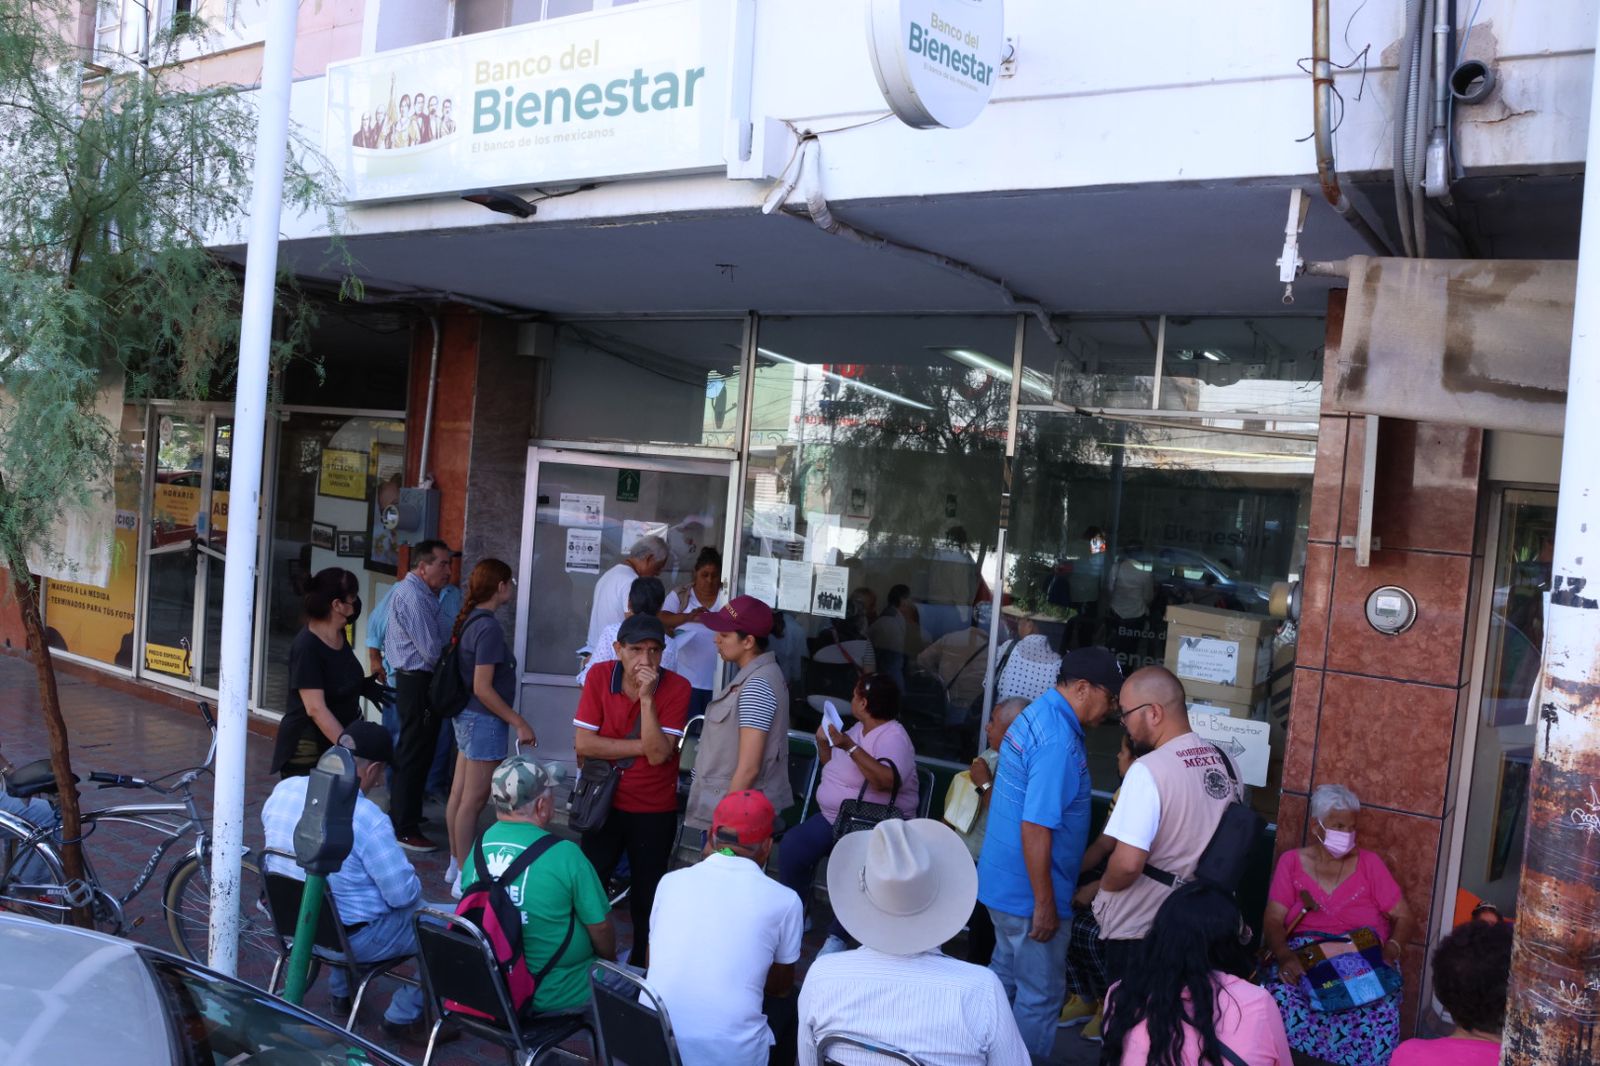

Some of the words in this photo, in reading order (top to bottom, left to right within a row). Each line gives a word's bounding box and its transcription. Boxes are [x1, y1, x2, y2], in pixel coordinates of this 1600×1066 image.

[931, 12, 962, 41] Banco
[965, 30, 980, 50] del
[475, 54, 551, 85] Banco
[560, 39, 600, 71] del
[909, 21, 993, 86] Bienestar
[473, 67, 705, 134] Bienestar
[472, 142, 480, 153] El
[484, 139, 517, 152] banco
[518, 136, 531, 148] de
[535, 135, 550, 146] los
[553, 127, 615, 143] mexicanos
[163, 489, 195, 499] HORARIO
[51, 583, 73, 594] MARCOS
[80, 588, 87, 596] LA
[88, 589, 110, 601] MEDIDA
[51, 596, 85, 610] TERMINADOS
[87, 603, 102, 613] PARA
[103, 607, 115, 617] TUS
[1118, 625, 1155, 640] Banco
[1209, 714, 1263, 735] Bienestar
